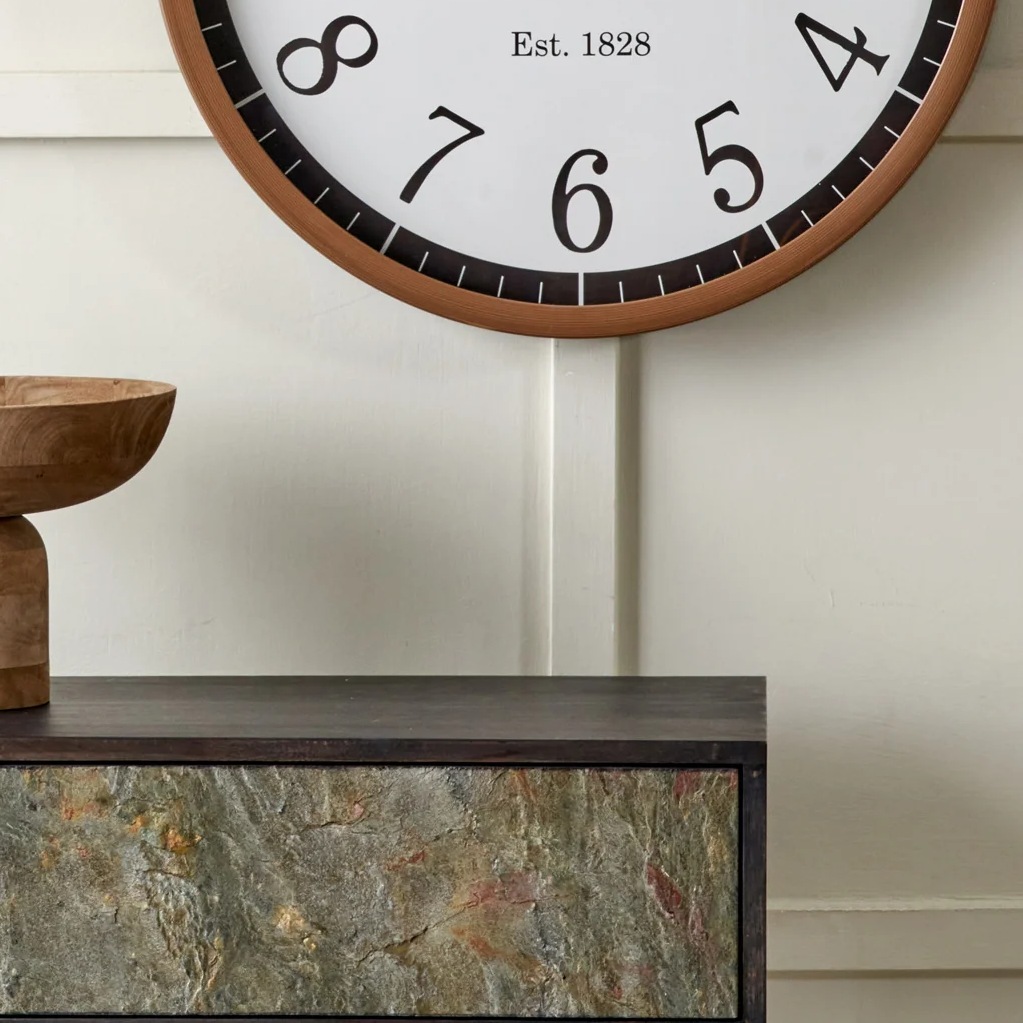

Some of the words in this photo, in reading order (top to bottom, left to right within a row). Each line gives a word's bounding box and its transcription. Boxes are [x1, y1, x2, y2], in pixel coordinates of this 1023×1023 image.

[276, 15, 379, 96] 8
[510, 31, 570, 57] Est.
[581, 31, 652, 57] 1828
[794, 12, 890, 93] 4
[399, 105, 485, 204] 7
[694, 99, 764, 214] 5
[551, 148, 614, 254] 6
